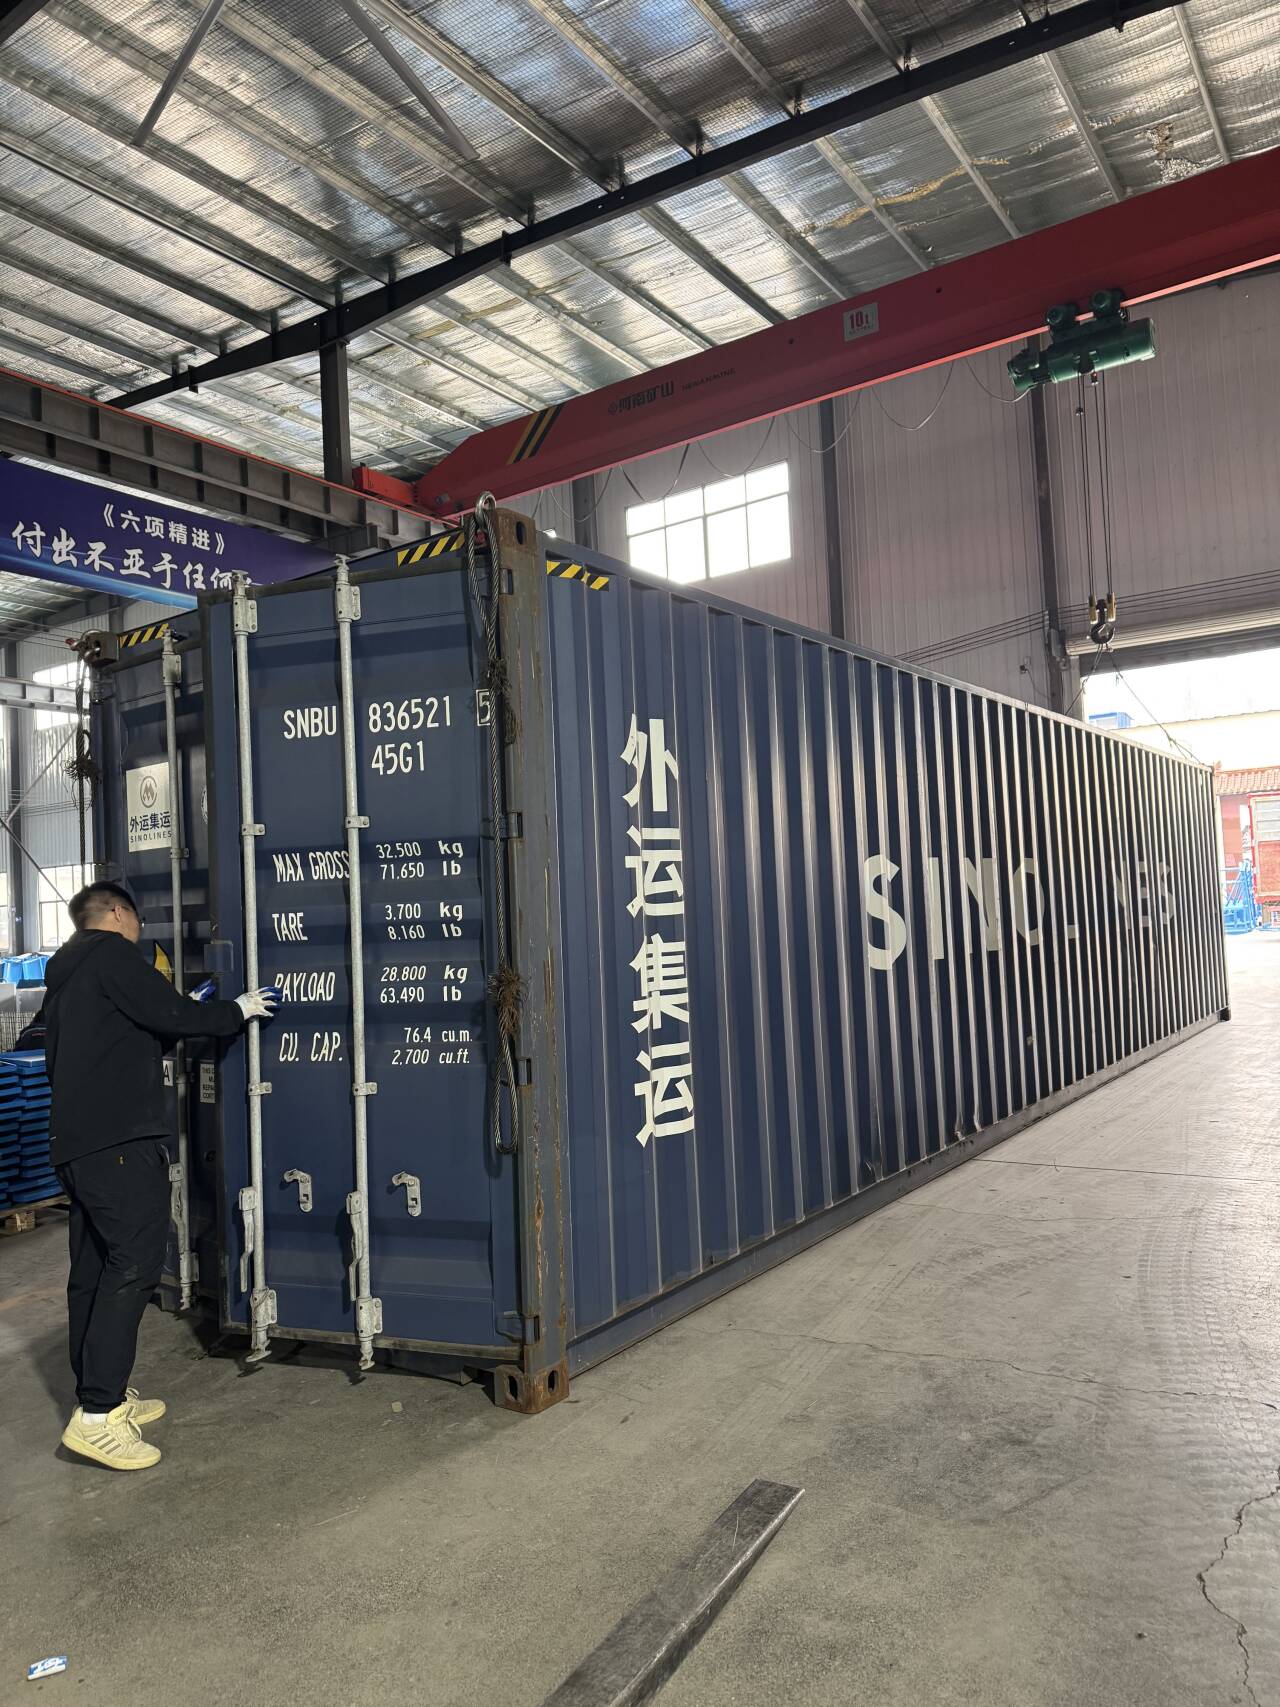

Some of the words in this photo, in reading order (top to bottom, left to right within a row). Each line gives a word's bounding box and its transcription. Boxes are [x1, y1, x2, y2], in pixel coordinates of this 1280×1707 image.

[103, 503, 225, 555] 《六项精进》
[11, 521, 263, 591] 付出不亚于任何
[283, 705, 337, 740] SNBU
[368, 695, 451, 734] 836521
[479, 692, 491, 723] 5
[371, 740, 425, 776] 45G1
[129, 811, 171, 833] 外运集运
[130, 831, 172, 844] SINOLINES
[272, 852, 305, 883] MAX
[308, 850, 350, 880] GROSS
[438, 840, 464, 857] kg
[442, 861, 461, 876] lb
[272, 912, 308, 942] TARE
[439, 902, 463, 920] kg
[442, 923, 462, 938] lb
[619, 713, 695, 1149] 外运集运
[274, 971, 336, 1002] PAYLOAD
[443, 964, 468, 982] kg
[443, 986, 462, 1001] lb
[279, 1031, 300, 1062] CU.
[310, 1031, 343, 1062] CAP.
[403, 1026, 432, 1043] 76.4
[441, 1029, 473, 1042] cu.m.
[438, 1048, 470, 1064] cu.ft.
